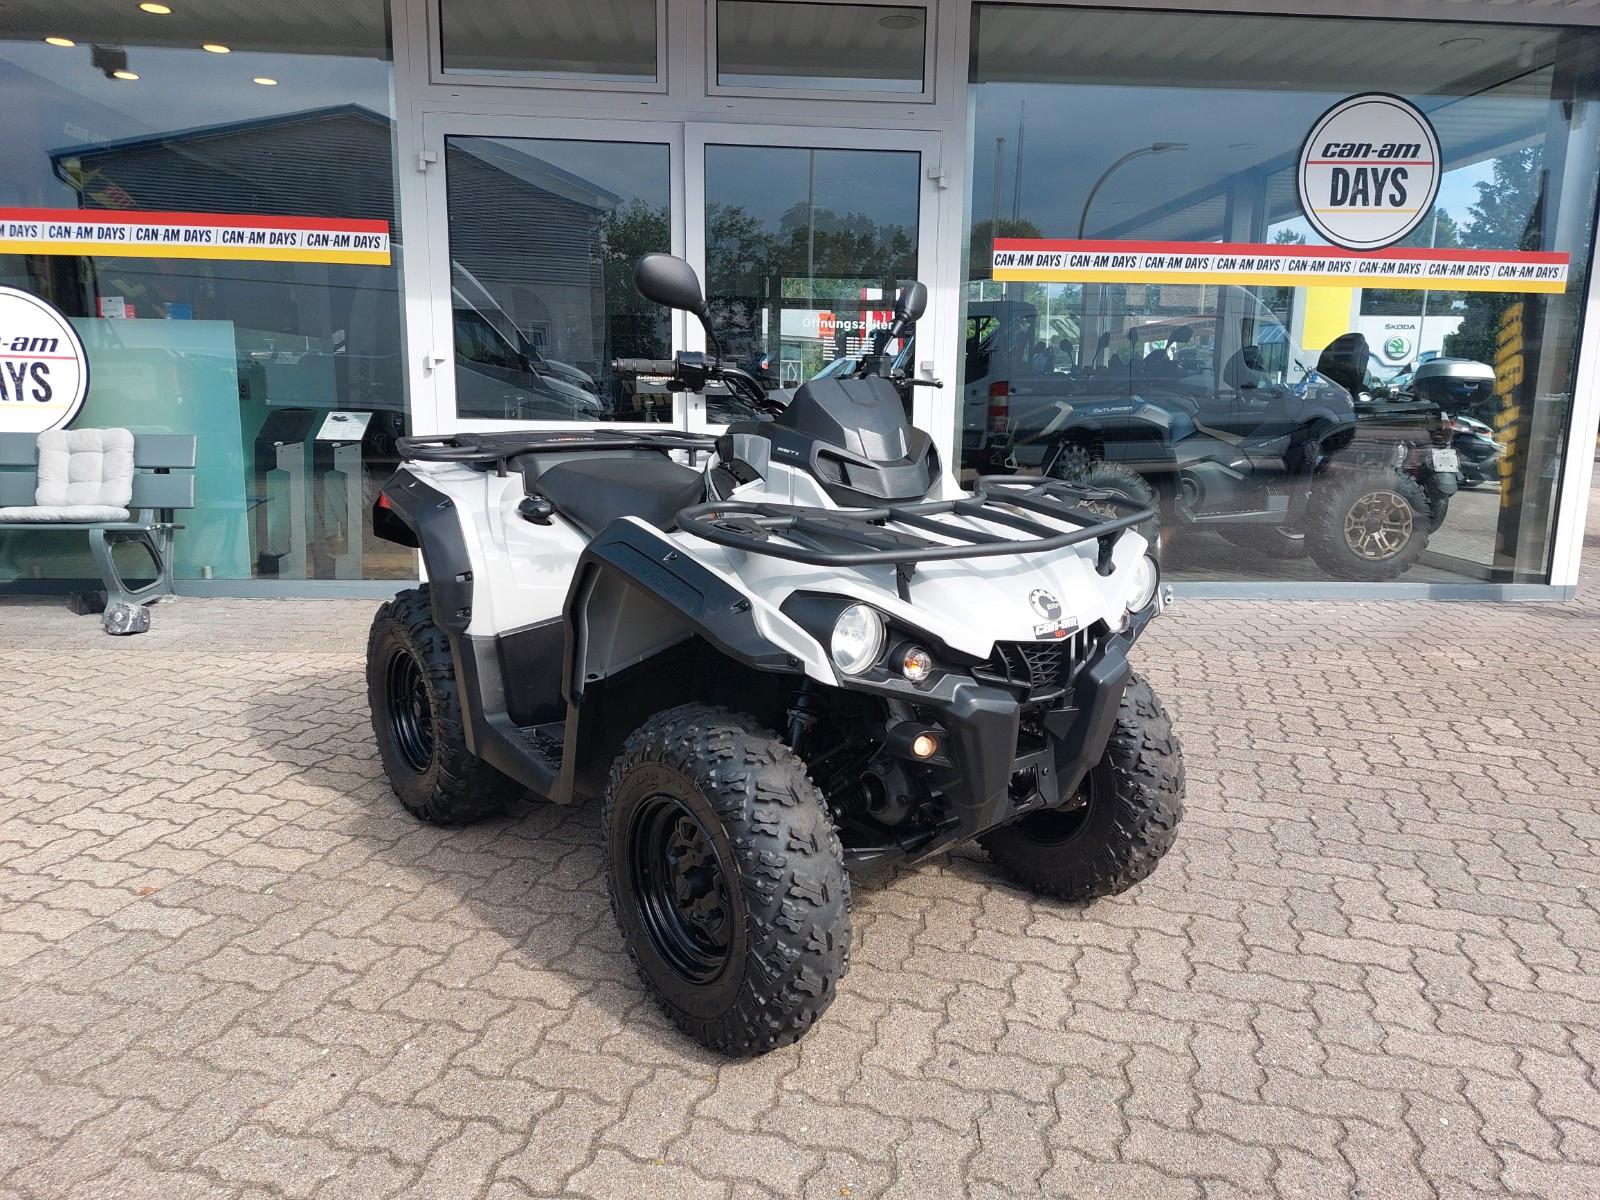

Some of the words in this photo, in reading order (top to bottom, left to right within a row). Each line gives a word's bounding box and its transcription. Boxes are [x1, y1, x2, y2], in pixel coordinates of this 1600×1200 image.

[1321, 142, 1421, 159] can-am
[1329, 166, 1408, 208] DAYS
[10, 224, 37, 238] DAYS
[49, 225, 94, 240] CAN-AM
[97, 226, 126, 241] DAYS
[136, 227, 180, 242] CAN-AM
[184, 229, 212, 243] DAYS
[222, 230, 266, 244] CAN-AM
[269, 231, 297, 246] DAYS
[307, 233, 350, 248] CAN-AM
[353, 235, 381, 249] DAYS
[994, 253, 1033, 266] CAN-AM
[1036, 254, 1062, 267] DAYS
[1070, 255, 1109, 268] CAN-AM
[1111, 255, 1137, 269] DAYS
[1145, 256, 1183, 269] CAN-AM
[1184, 257, 1210, 270] DAYS
[1217, 257, 1256, 270] CAN-AM
[1256, 258, 1280, 271] DAYS
[1288, 259, 1325, 272] CAN-AM
[1327, 260, 1352, 273] DAYS
[1359, 261, 1397, 274] CAN-AM
[1397, 262, 1422, 275] DAYS
[1429, 263, 1466, 276] CAN-AM
[1466, 264, 1491, 277] DAYS
[1498, 265, 1534, 278] CAN-AM
[1535, 266, 1560, 279] DAYS
[1384, 323, 1416, 331] ŠKODA
[0, 336, 59, 353] -am
